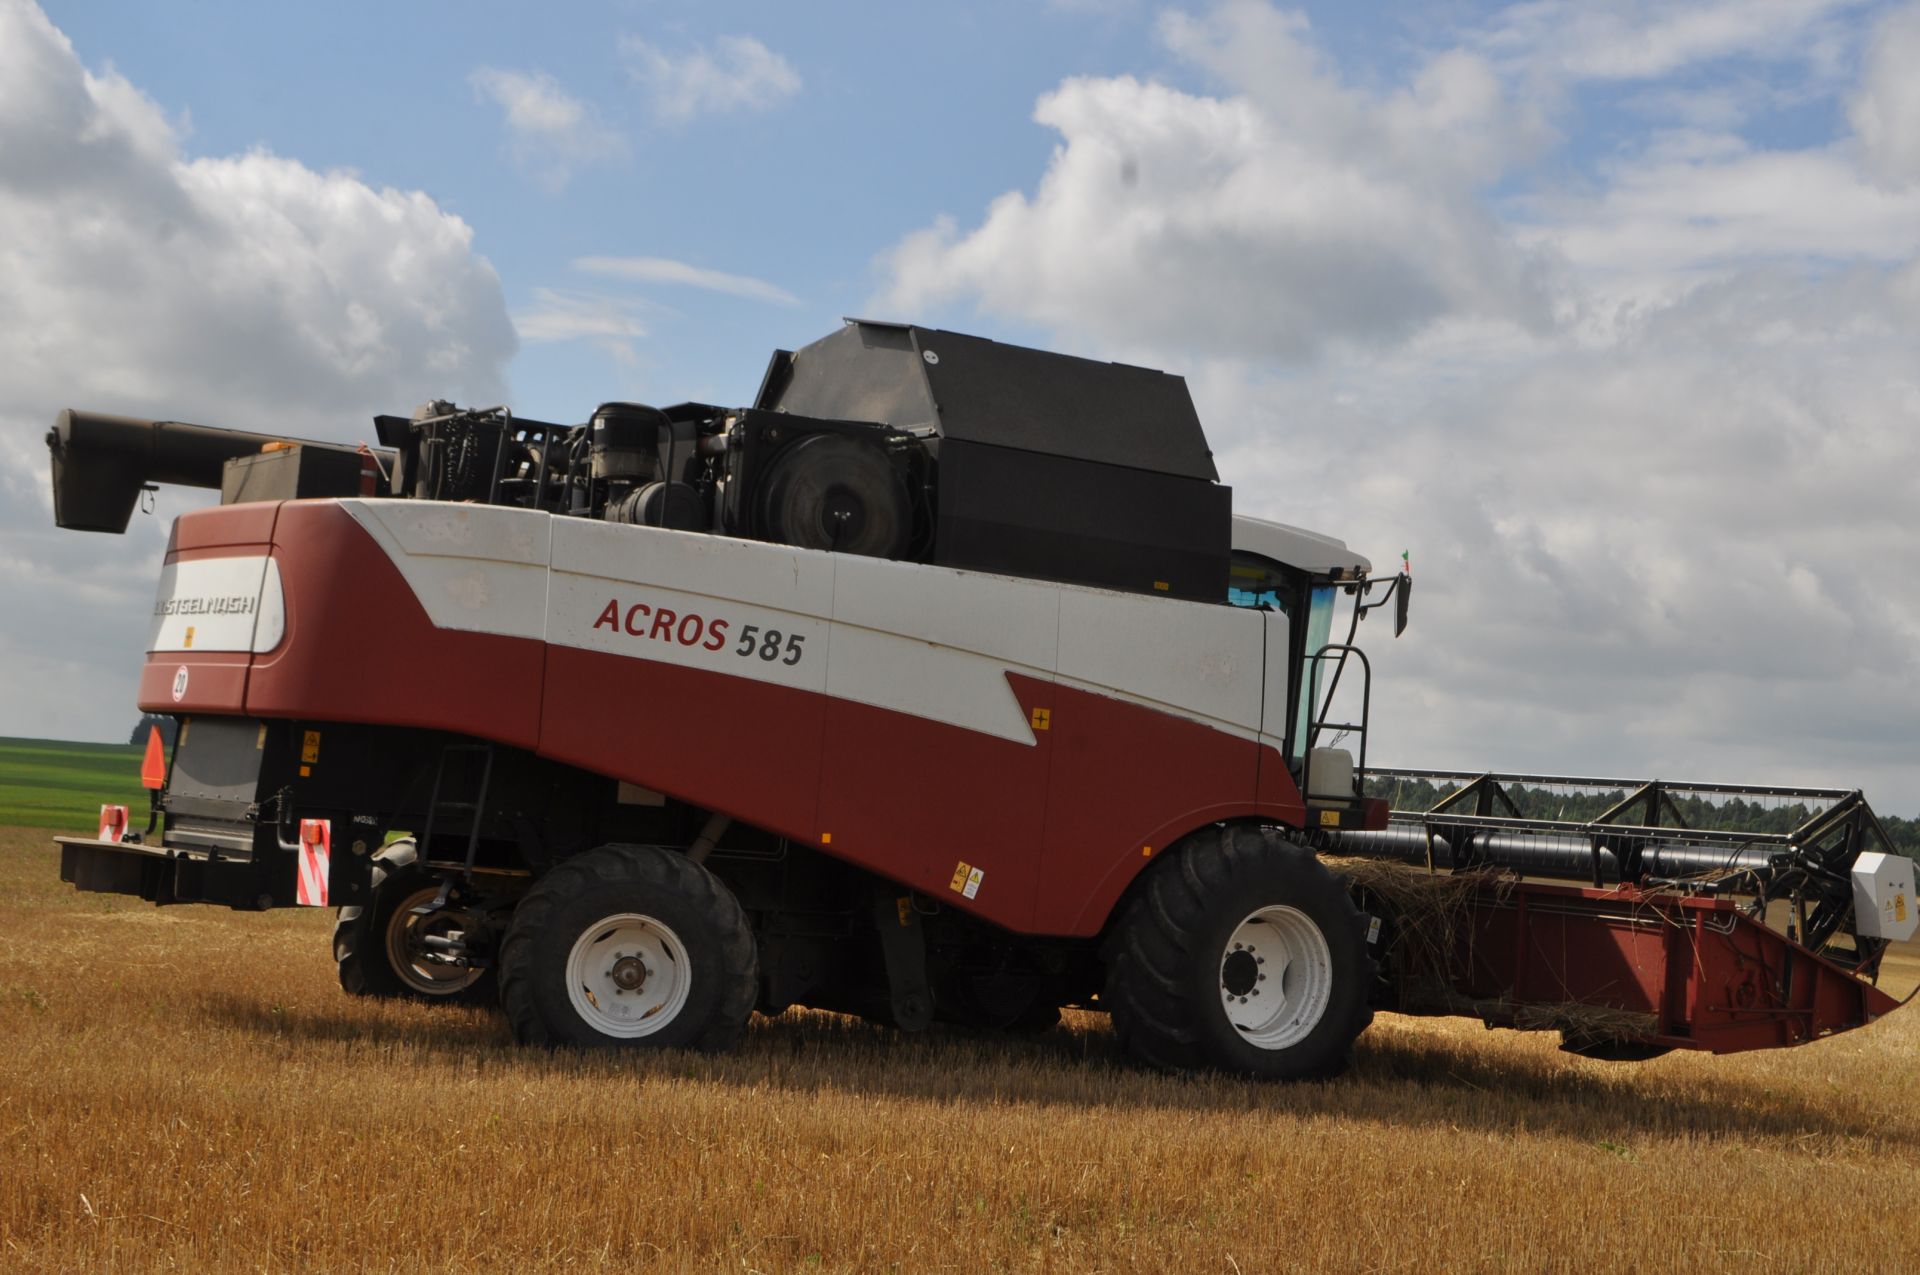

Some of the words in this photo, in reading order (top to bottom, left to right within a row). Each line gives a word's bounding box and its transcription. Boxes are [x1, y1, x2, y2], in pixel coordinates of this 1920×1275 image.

[593, 599, 729, 651] ACROS
[736, 624, 806, 666] 585
[174, 672, 186, 693] 20
